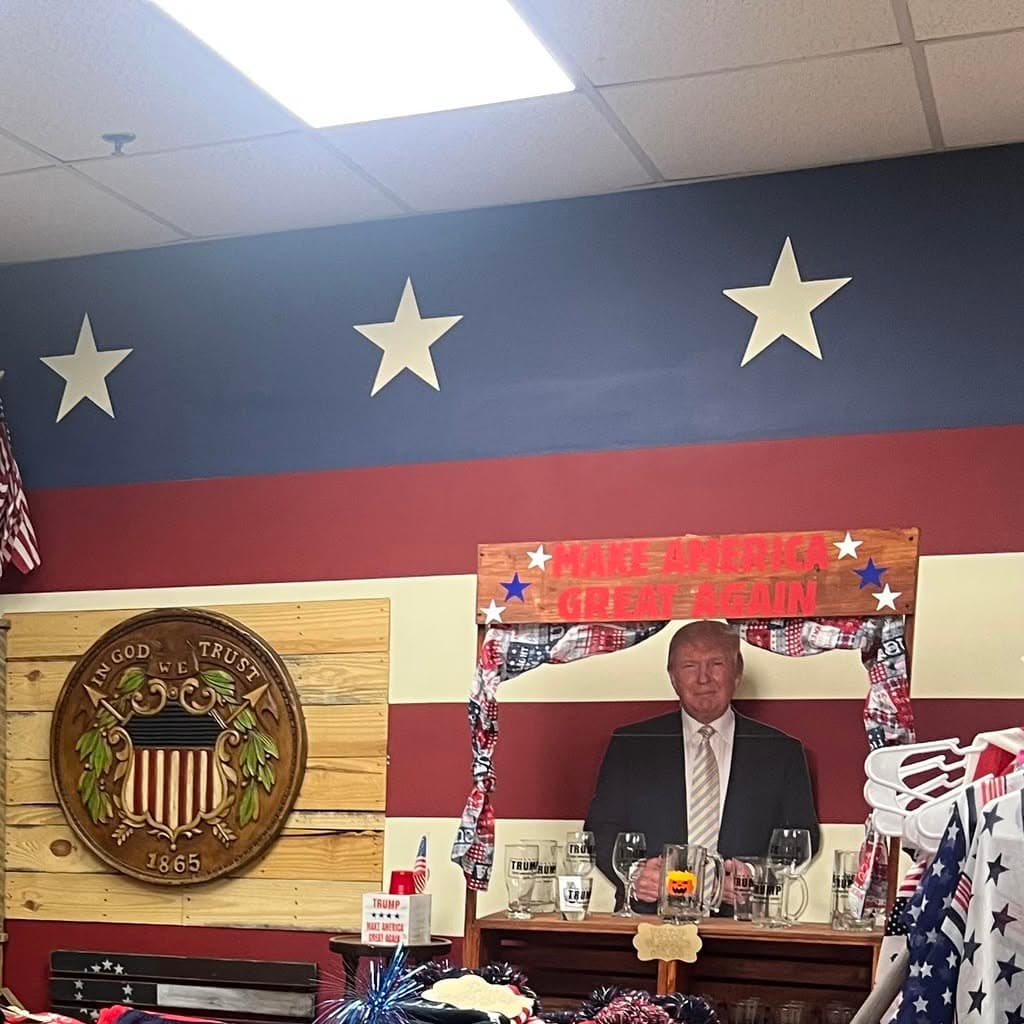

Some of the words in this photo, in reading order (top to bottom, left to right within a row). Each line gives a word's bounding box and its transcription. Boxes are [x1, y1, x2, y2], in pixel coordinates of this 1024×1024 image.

[551, 542, 651, 578] MAKE
[663, 534, 830, 573] AMERICA
[556, 583, 677, 621] GREAT
[690, 580, 818, 618] AGAIN
[90, 663, 112, 688] IN
[111, 643, 151, 666] GOD
[159, 662, 189, 675] WE
[198, 640, 261, 684] TRUST
[146, 852, 202, 874] 1865
[373, 898, 401, 910] TRUMP
[381, 922, 404, 932] AMERICA
